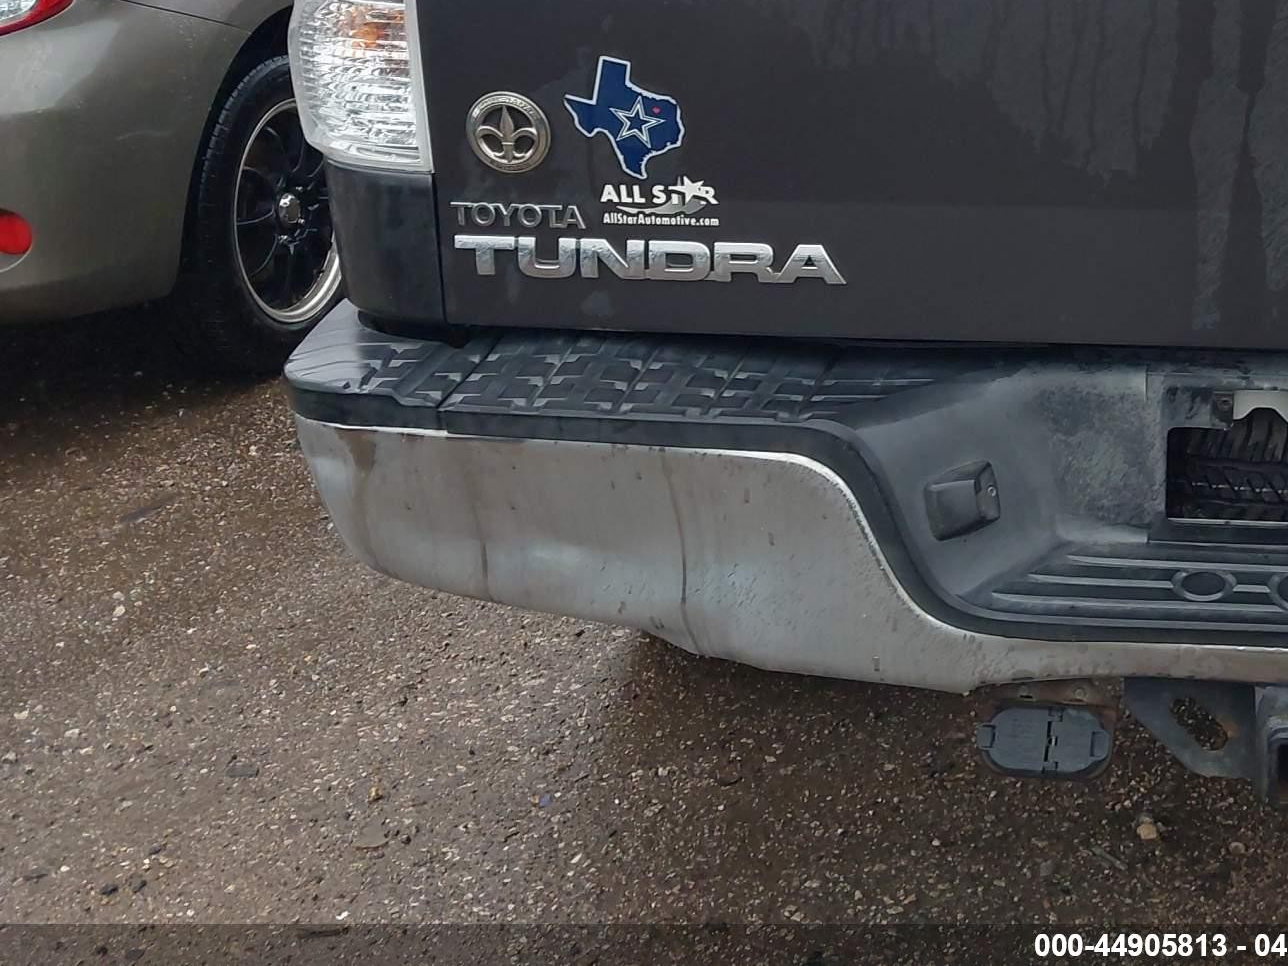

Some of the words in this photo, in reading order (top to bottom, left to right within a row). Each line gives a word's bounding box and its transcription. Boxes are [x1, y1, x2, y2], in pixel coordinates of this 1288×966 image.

[600, 184, 646, 203] ALL
[651, 176, 720, 205] STR
[449, 200, 587, 230] TOYOTA
[602, 212, 720, 227] AllStarAutomotive.com
[453, 235, 848, 286] TUNDRA
